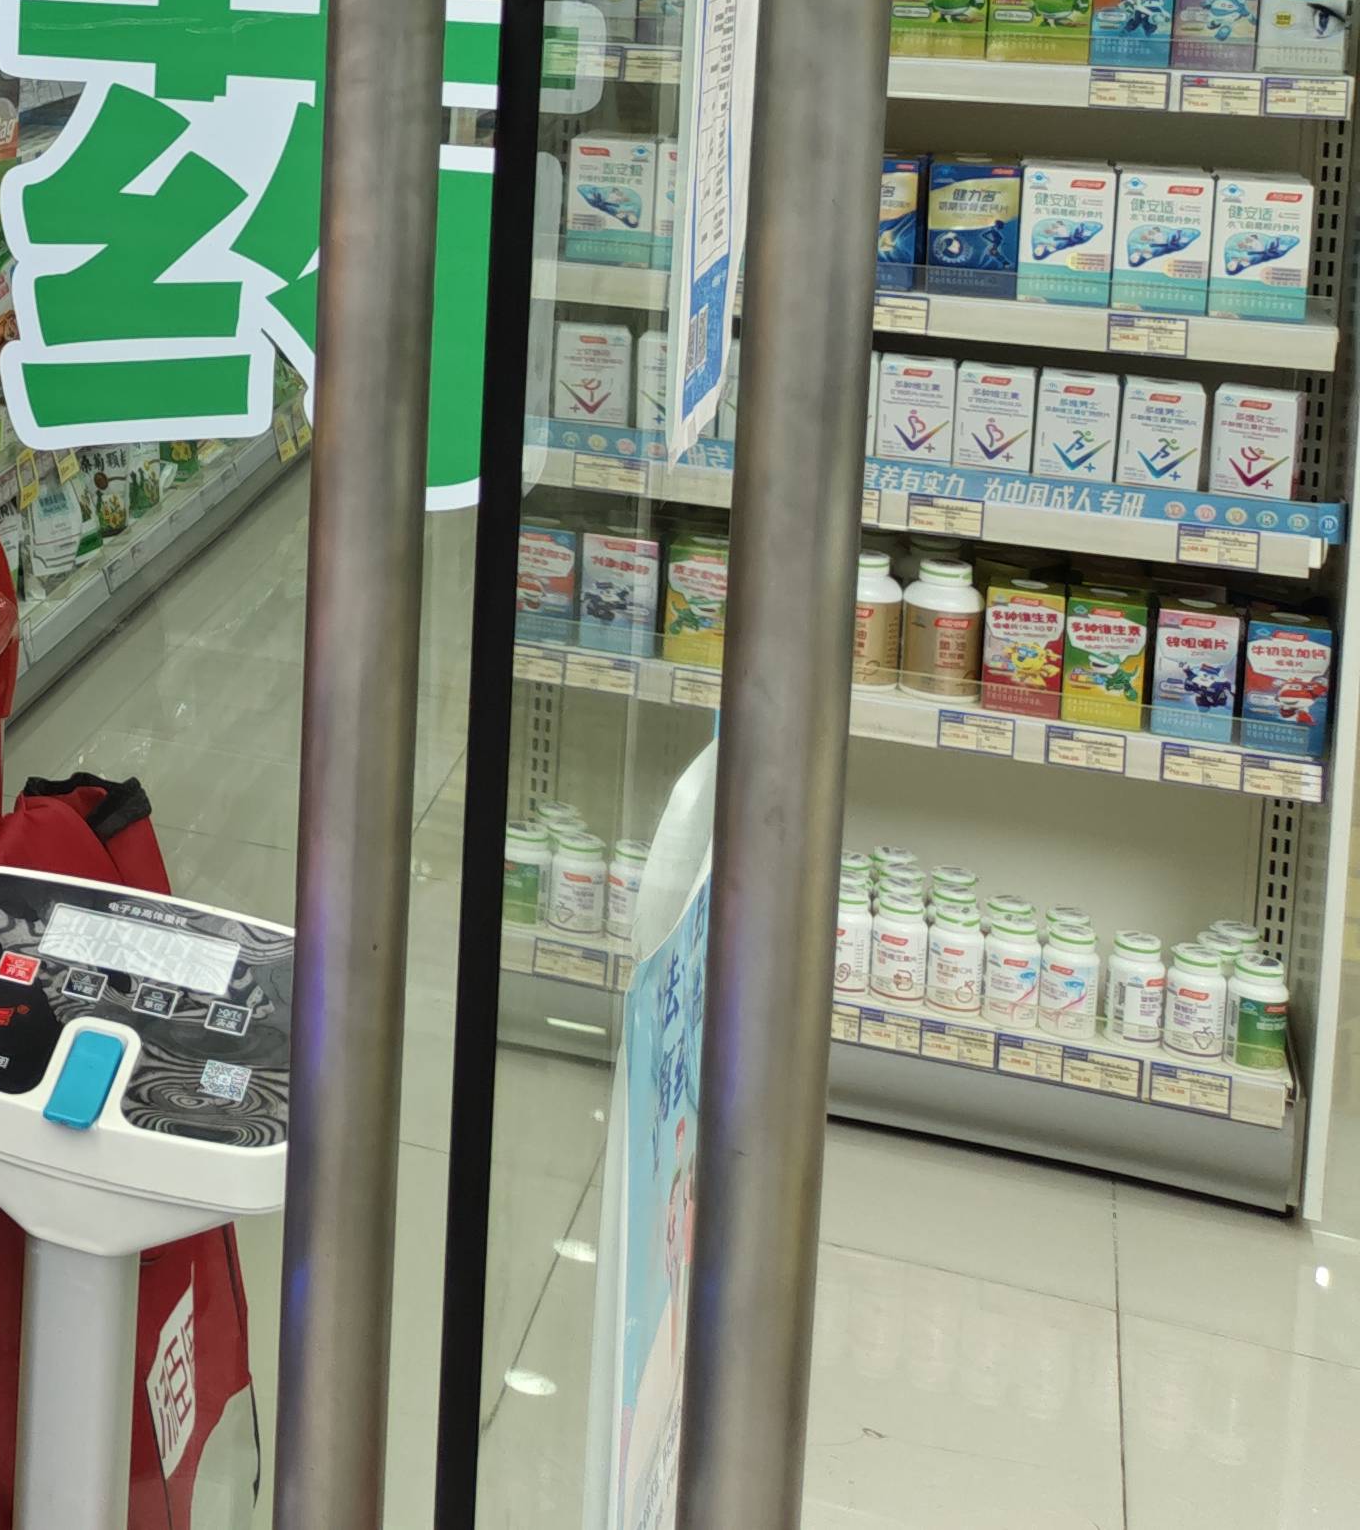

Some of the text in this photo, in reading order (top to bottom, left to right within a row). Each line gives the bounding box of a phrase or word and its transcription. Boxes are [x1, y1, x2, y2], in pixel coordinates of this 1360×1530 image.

[1034, 192, 1078, 208] 健安适
[1130, 198, 1175, 214] 健安适
[1228, 205, 1273, 222] 健安适
